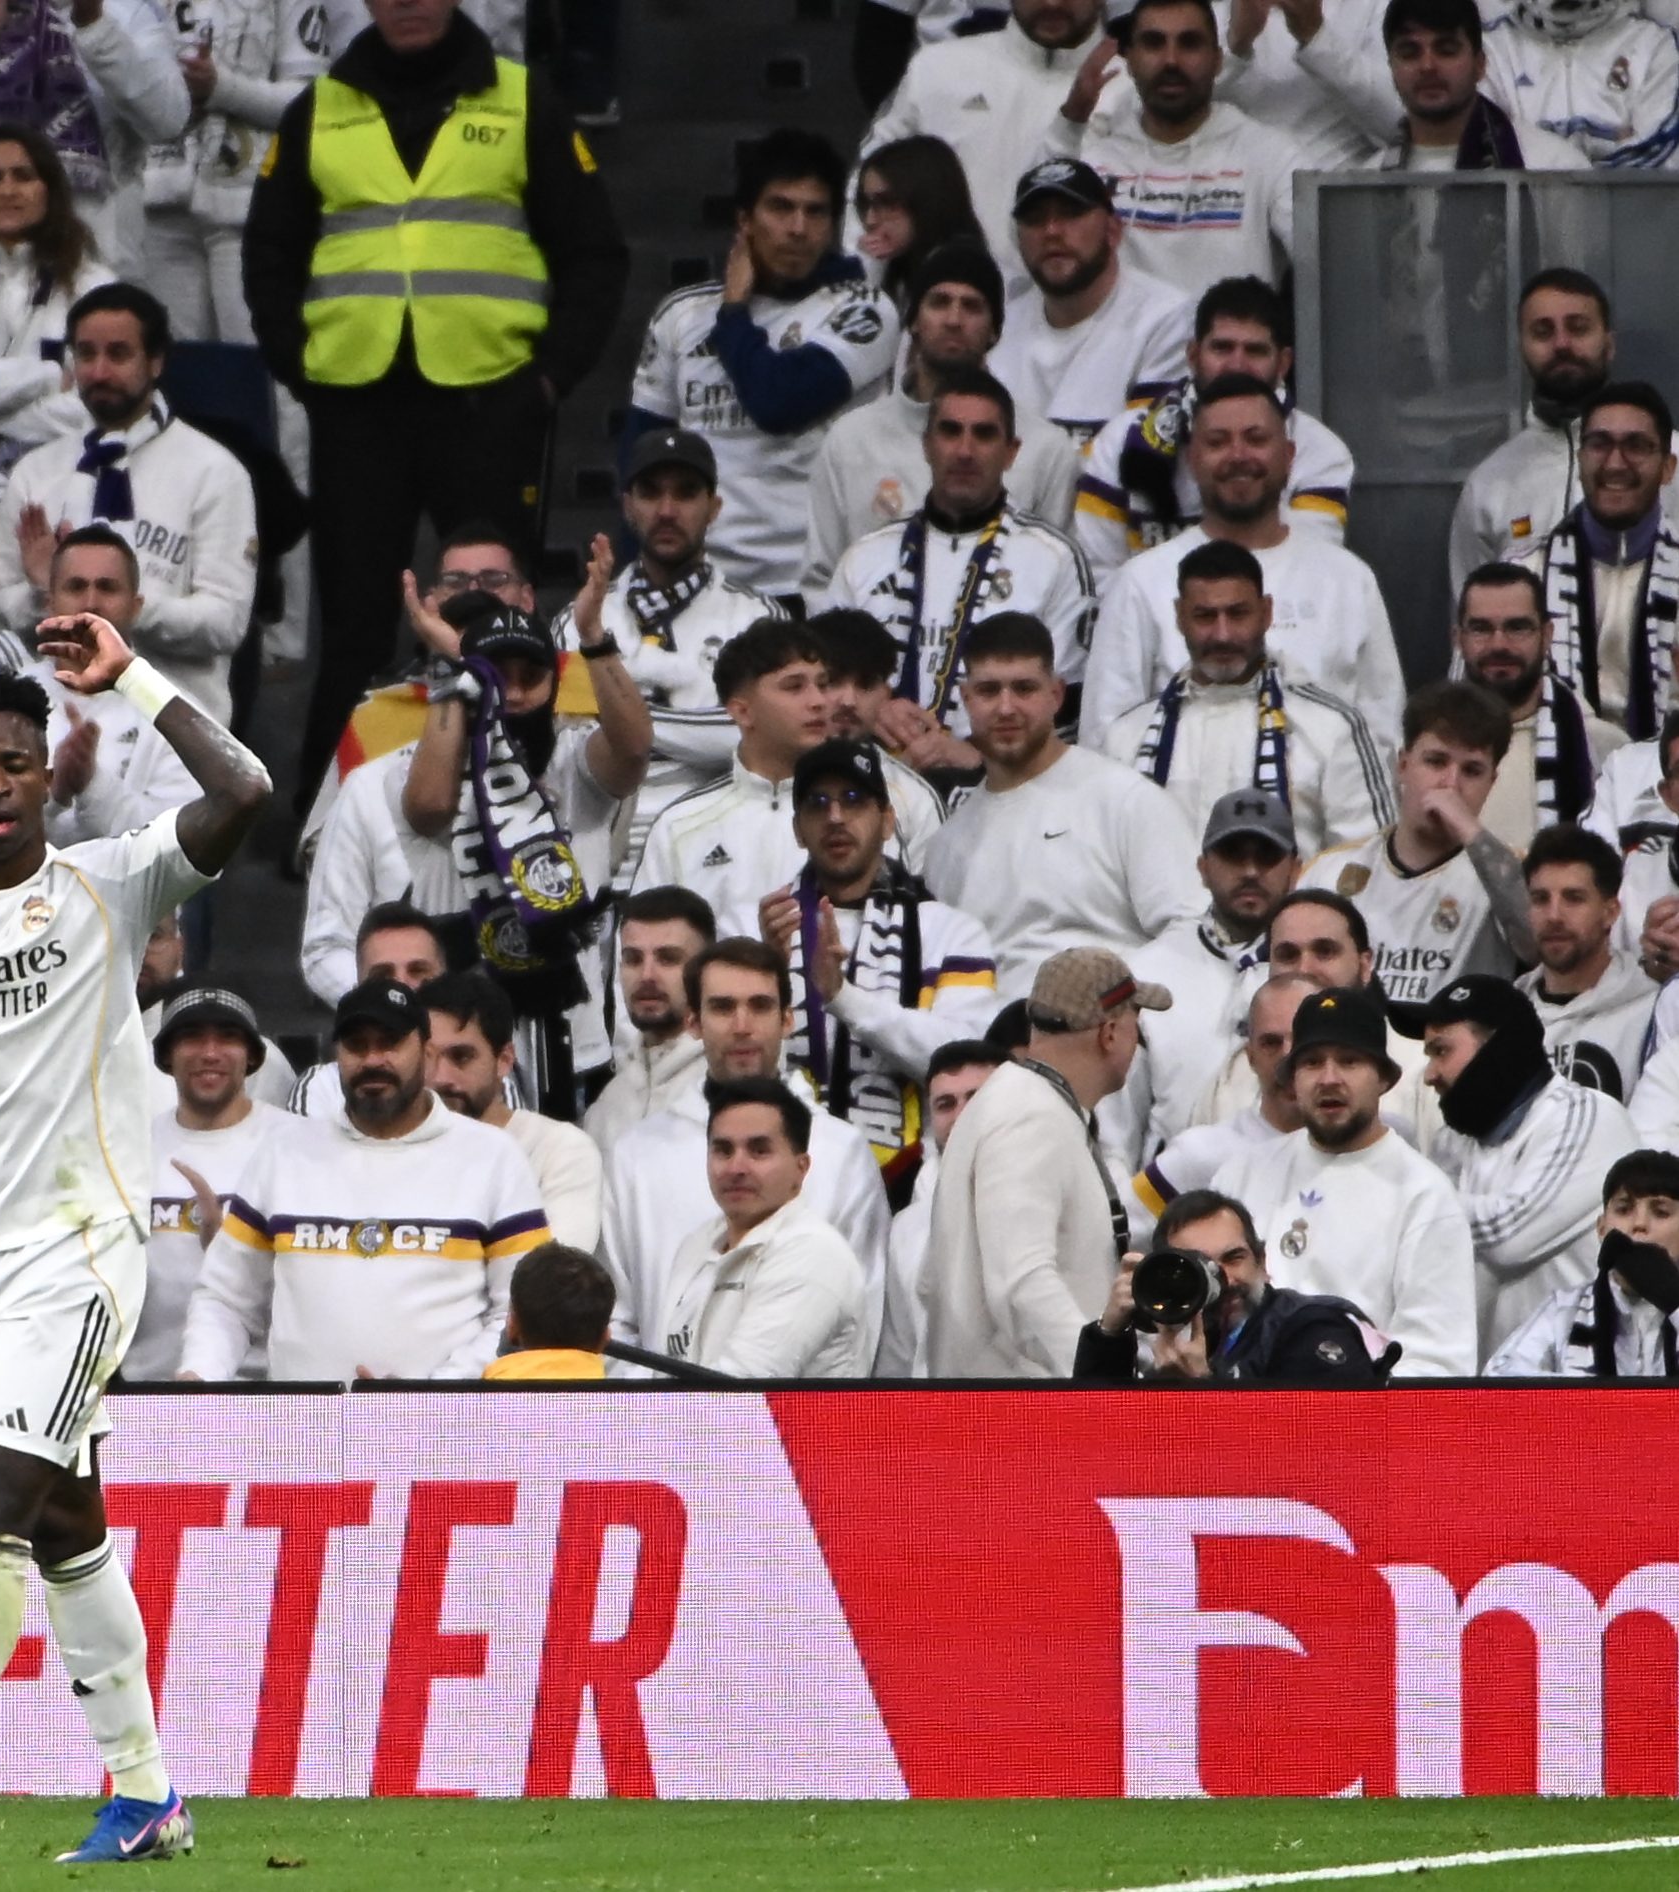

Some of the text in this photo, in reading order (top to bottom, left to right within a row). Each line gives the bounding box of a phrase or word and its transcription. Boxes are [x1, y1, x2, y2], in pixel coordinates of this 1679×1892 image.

[462, 122, 507, 145] 067
[292, 1213, 451, 1251] RM CF
[1095, 1495, 1679, 1798] Em
